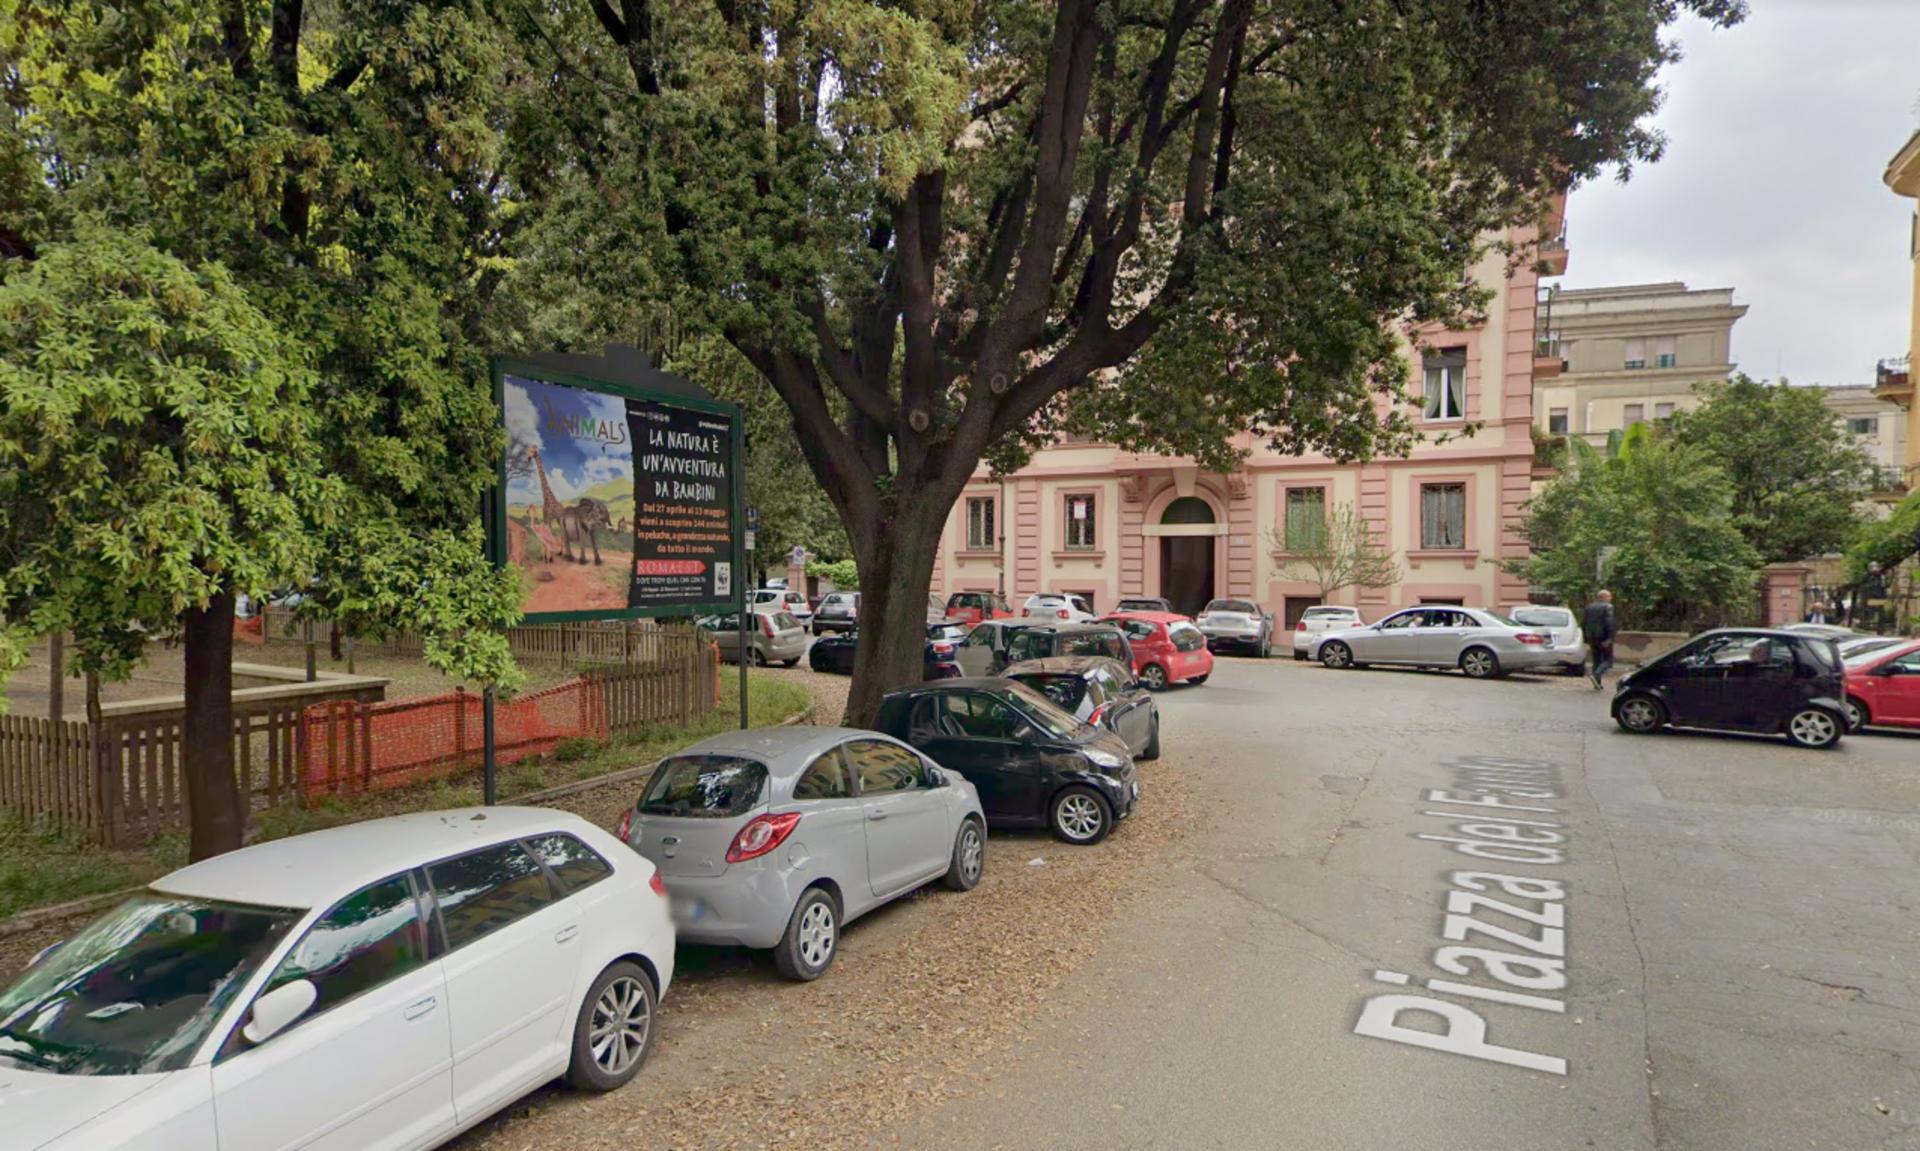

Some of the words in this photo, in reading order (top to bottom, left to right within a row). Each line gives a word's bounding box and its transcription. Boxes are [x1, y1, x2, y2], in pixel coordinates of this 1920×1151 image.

[649, 428, 664, 446] LA
[667, 430, 709, 453] NATURA
[712, 434, 719, 453] È
[642, 454, 725, 478] UN'AVVENTURA
[655, 481, 669, 497] DA
[673, 480, 716, 501] BAMBINI
[638, 561, 700, 574] ROMAEST
